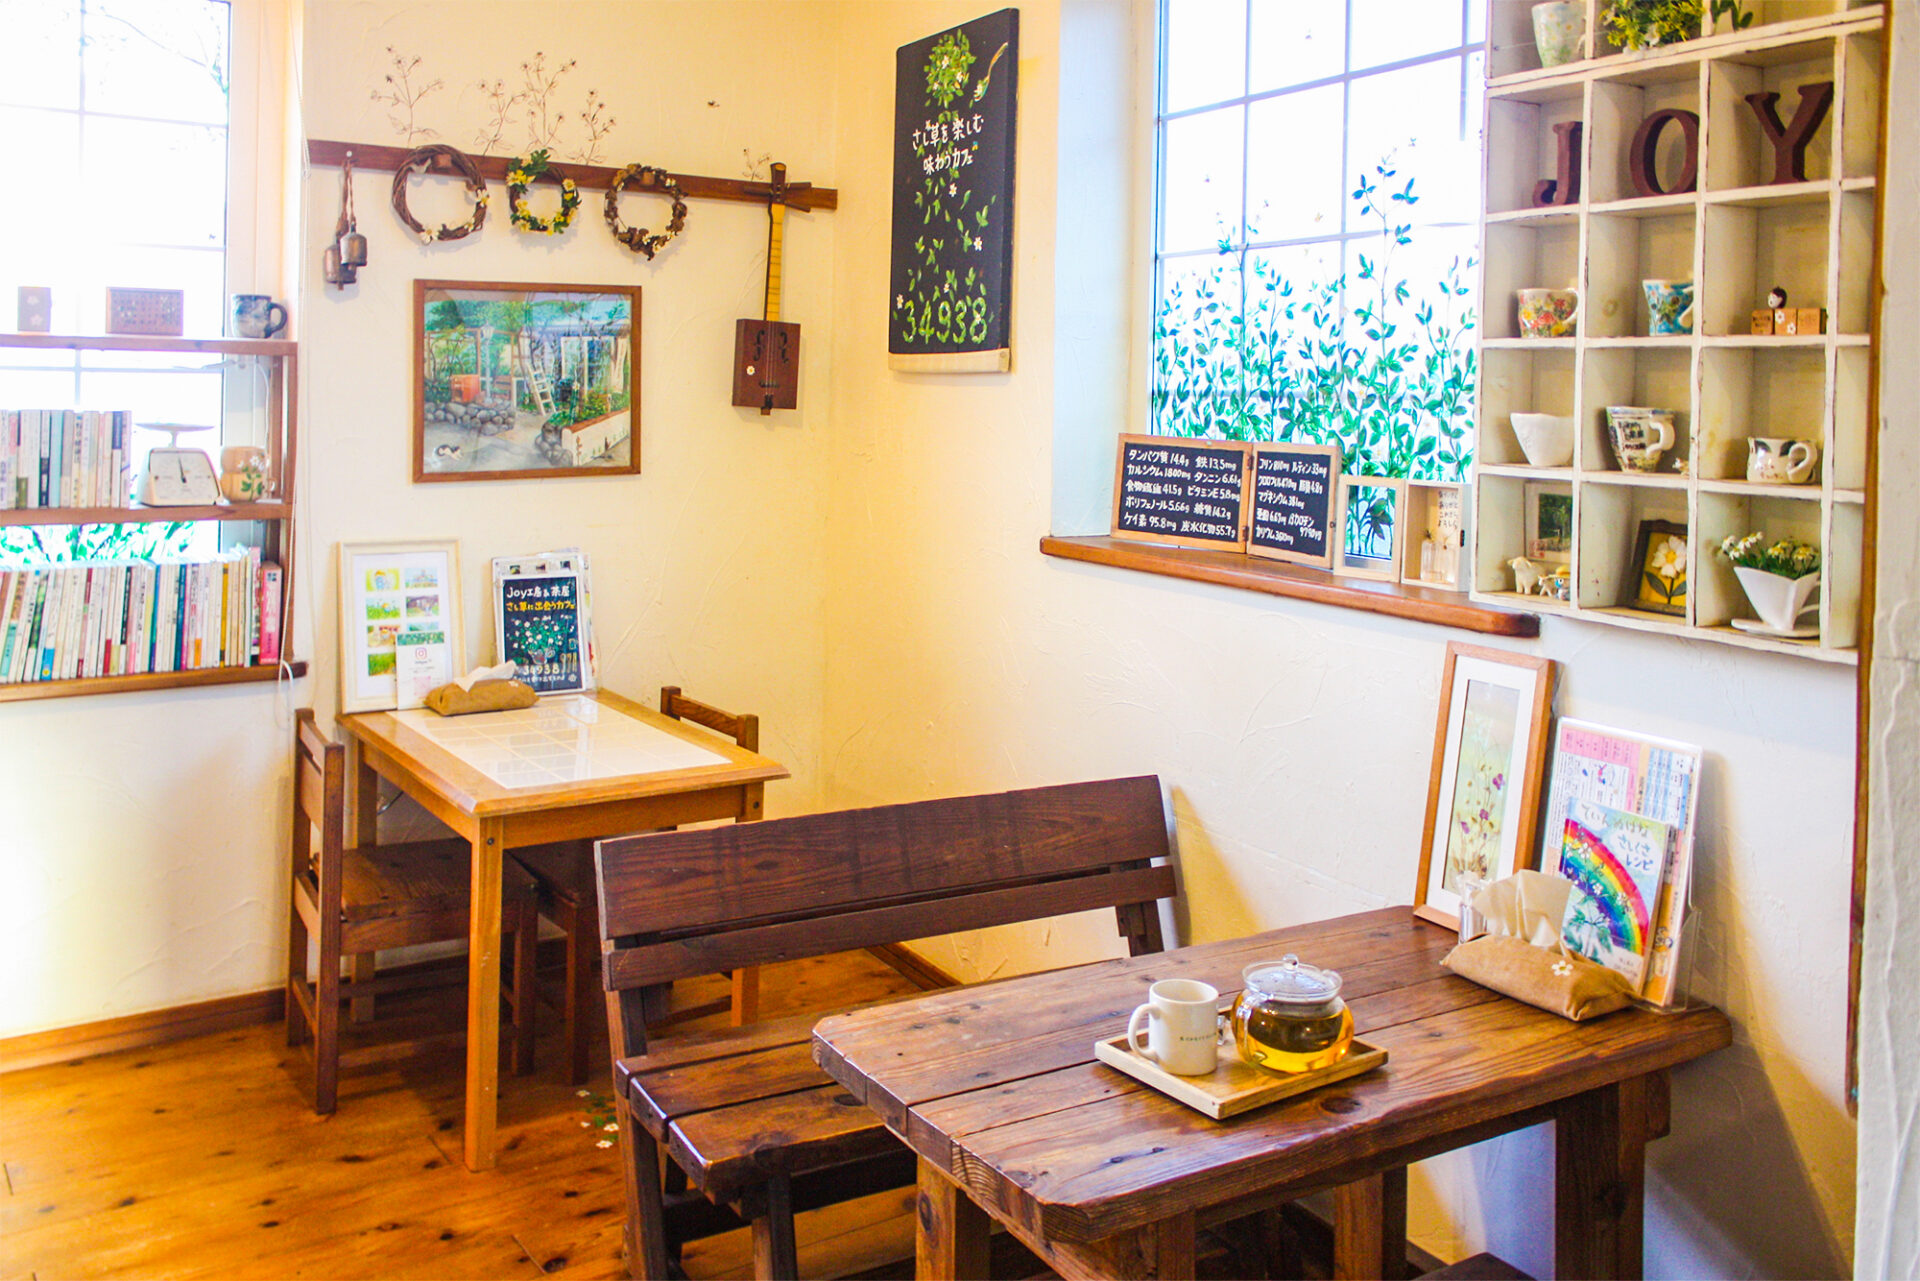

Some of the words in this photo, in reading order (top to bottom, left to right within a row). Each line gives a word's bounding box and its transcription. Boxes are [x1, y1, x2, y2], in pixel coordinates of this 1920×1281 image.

[923, 147, 974, 175] 味わうカフェ
[903, 296, 988, 345] 34938
